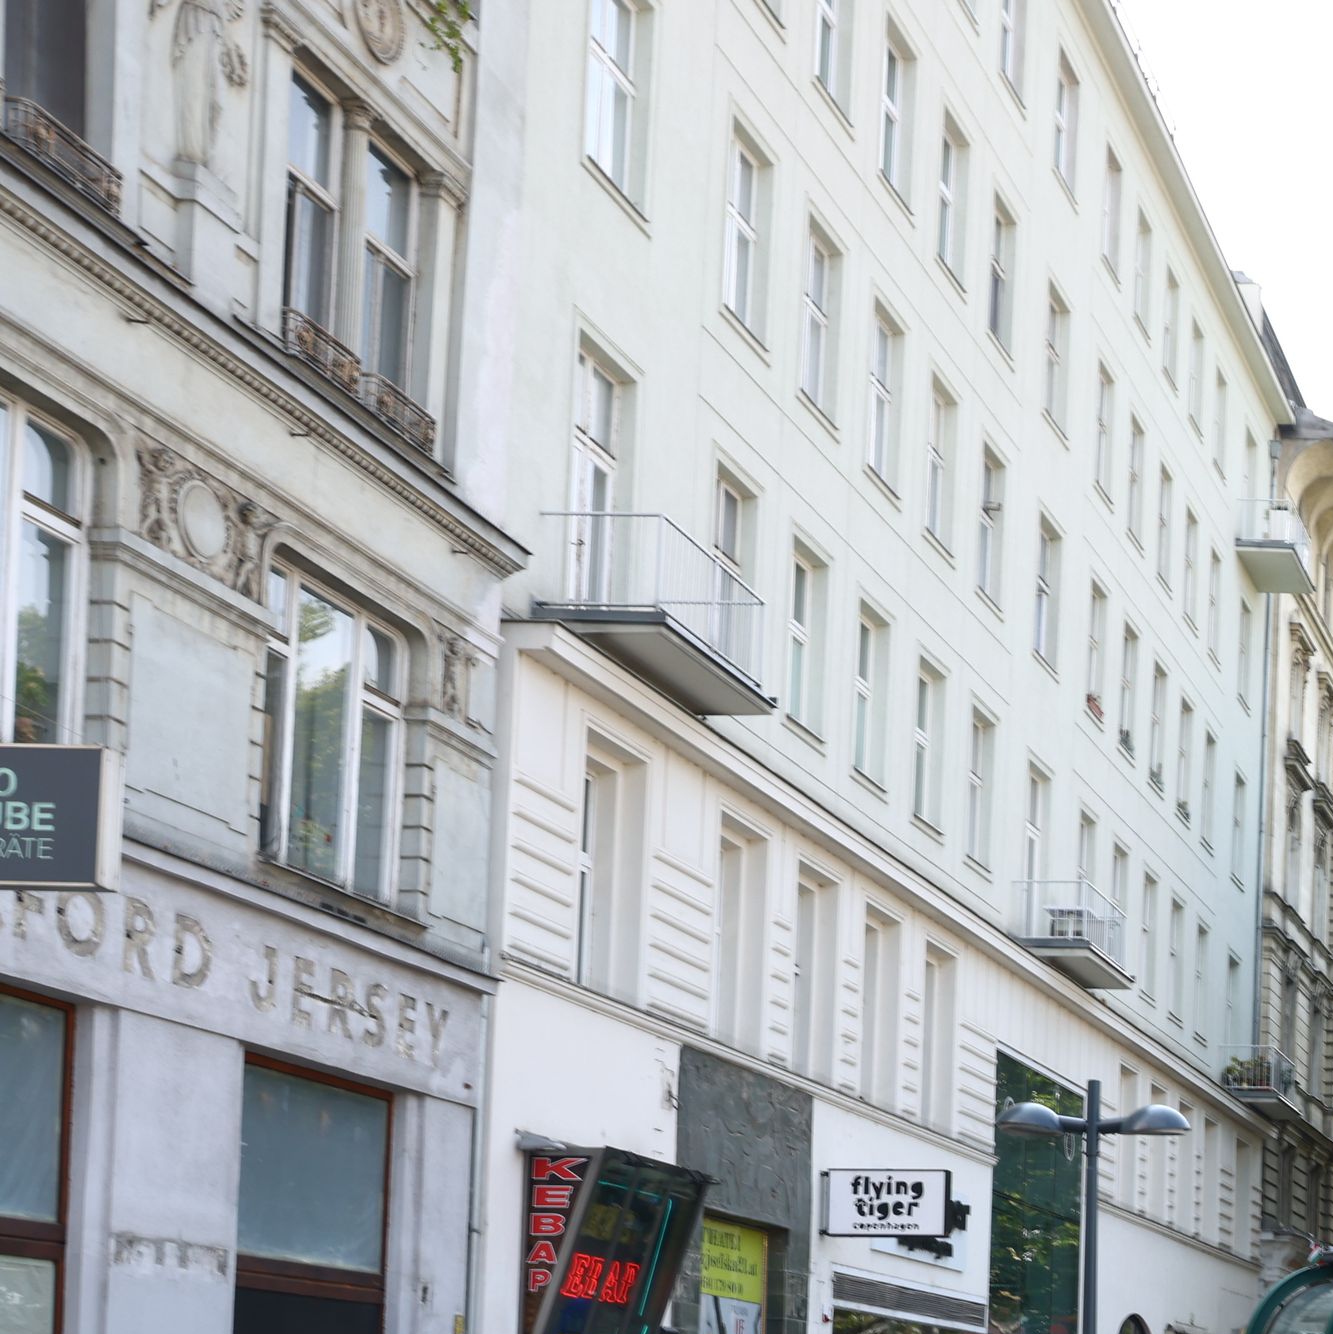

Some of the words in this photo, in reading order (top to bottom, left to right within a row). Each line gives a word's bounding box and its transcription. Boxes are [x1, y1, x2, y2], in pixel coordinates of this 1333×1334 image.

[0, 801, 56, 831] BE
[0, 888, 213, 989] FORD
[249, 943, 450, 1067] JERSEY
[851, 1175, 924, 1200] flying
[854, 1197, 919, 1221] tiger
[525, 1157, 589, 1292] KEBAP
[852, 1221, 920, 1233] copenhagen
